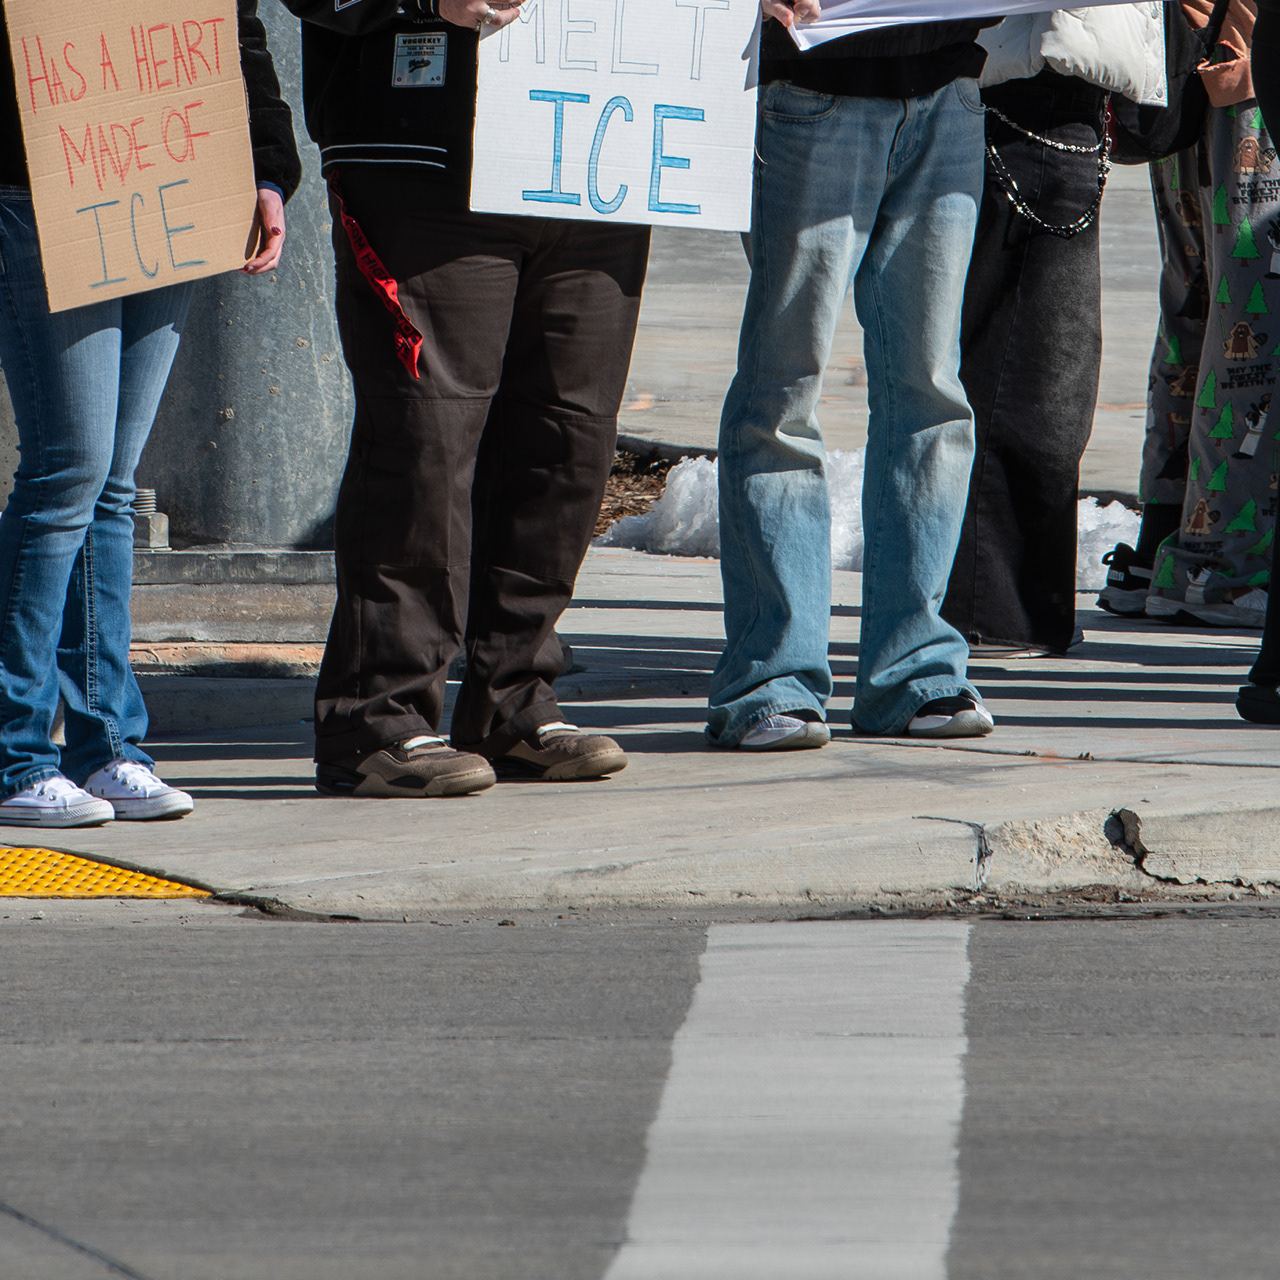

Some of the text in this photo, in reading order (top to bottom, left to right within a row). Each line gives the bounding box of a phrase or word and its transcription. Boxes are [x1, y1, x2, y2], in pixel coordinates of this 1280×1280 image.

[21, 17, 225, 113] HAS A HEART
[58, 101, 210, 191] MADE OF
[521, 89, 705, 215] ICE
[1236, 181, 1258, 189] MAY
[76, 179, 211, 290] ICE
